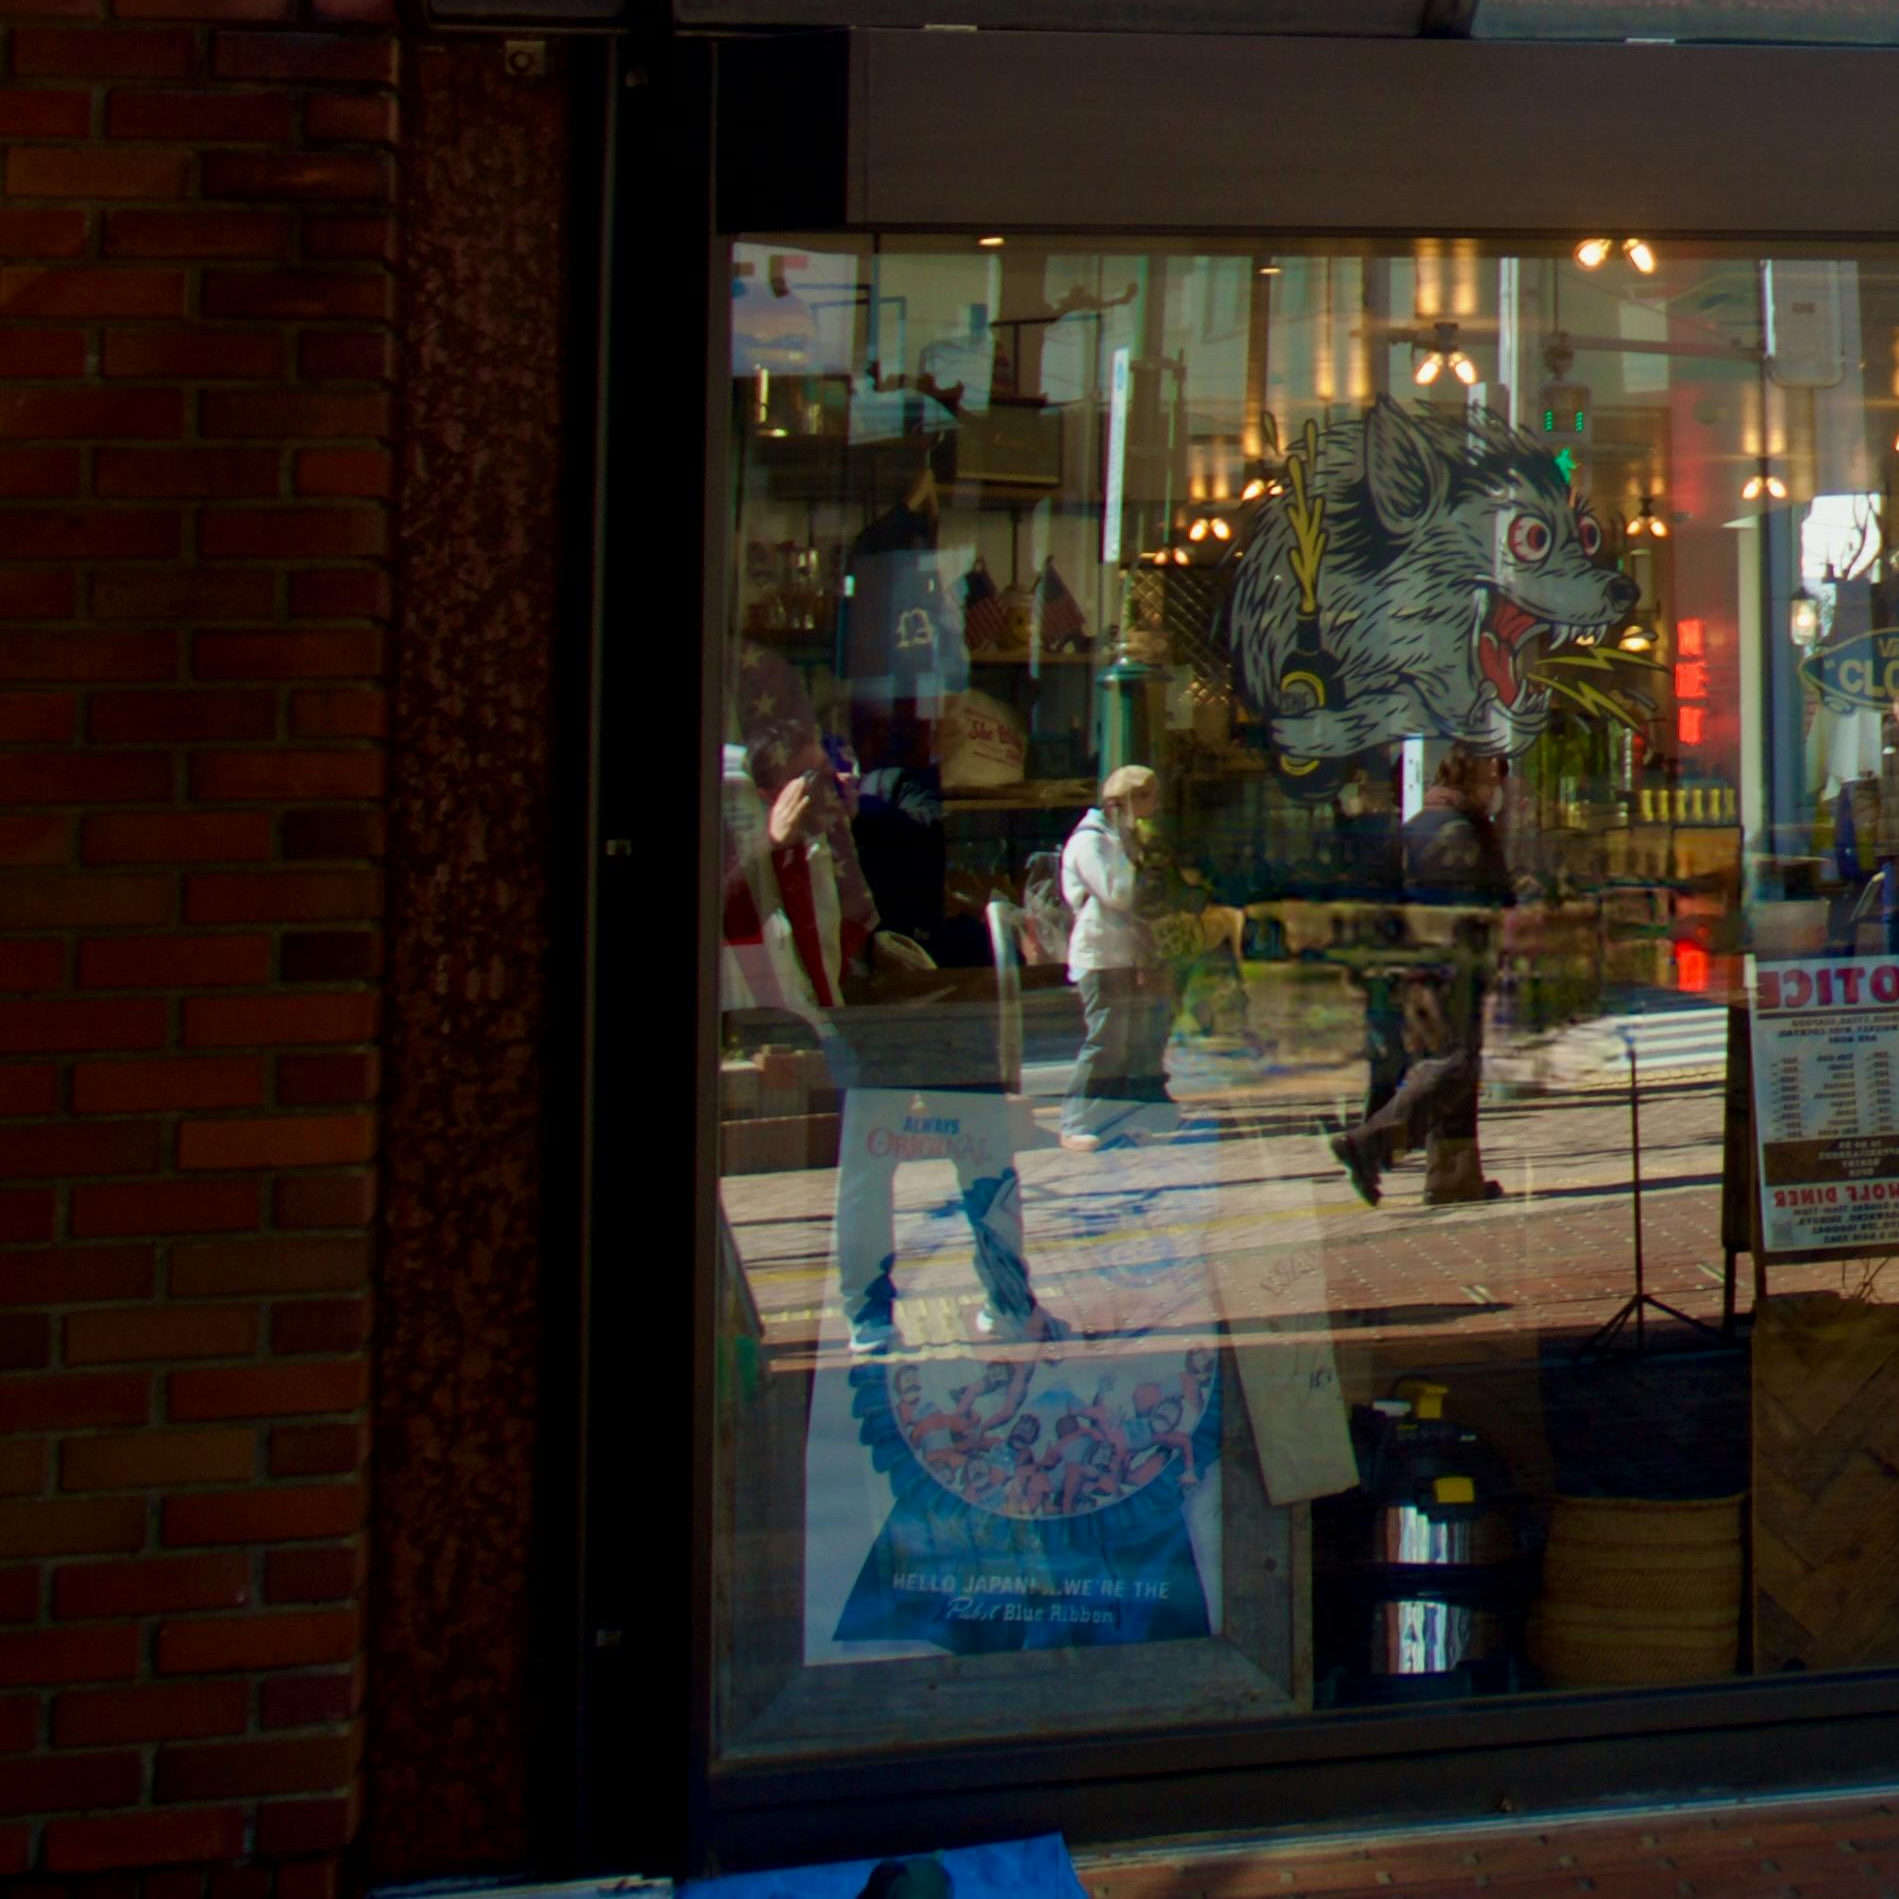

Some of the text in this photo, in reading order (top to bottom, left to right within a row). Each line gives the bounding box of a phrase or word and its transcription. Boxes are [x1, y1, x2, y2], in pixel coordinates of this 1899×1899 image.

[904, 1116, 960, 1135] ALWAYS
[891, 1572, 957, 1594] HELLO
[1132, 1580, 1170, 1600] THE
[1003, 1602, 1044, 1622] Blue
[1049, 1605, 1113, 1624] Ribbon
